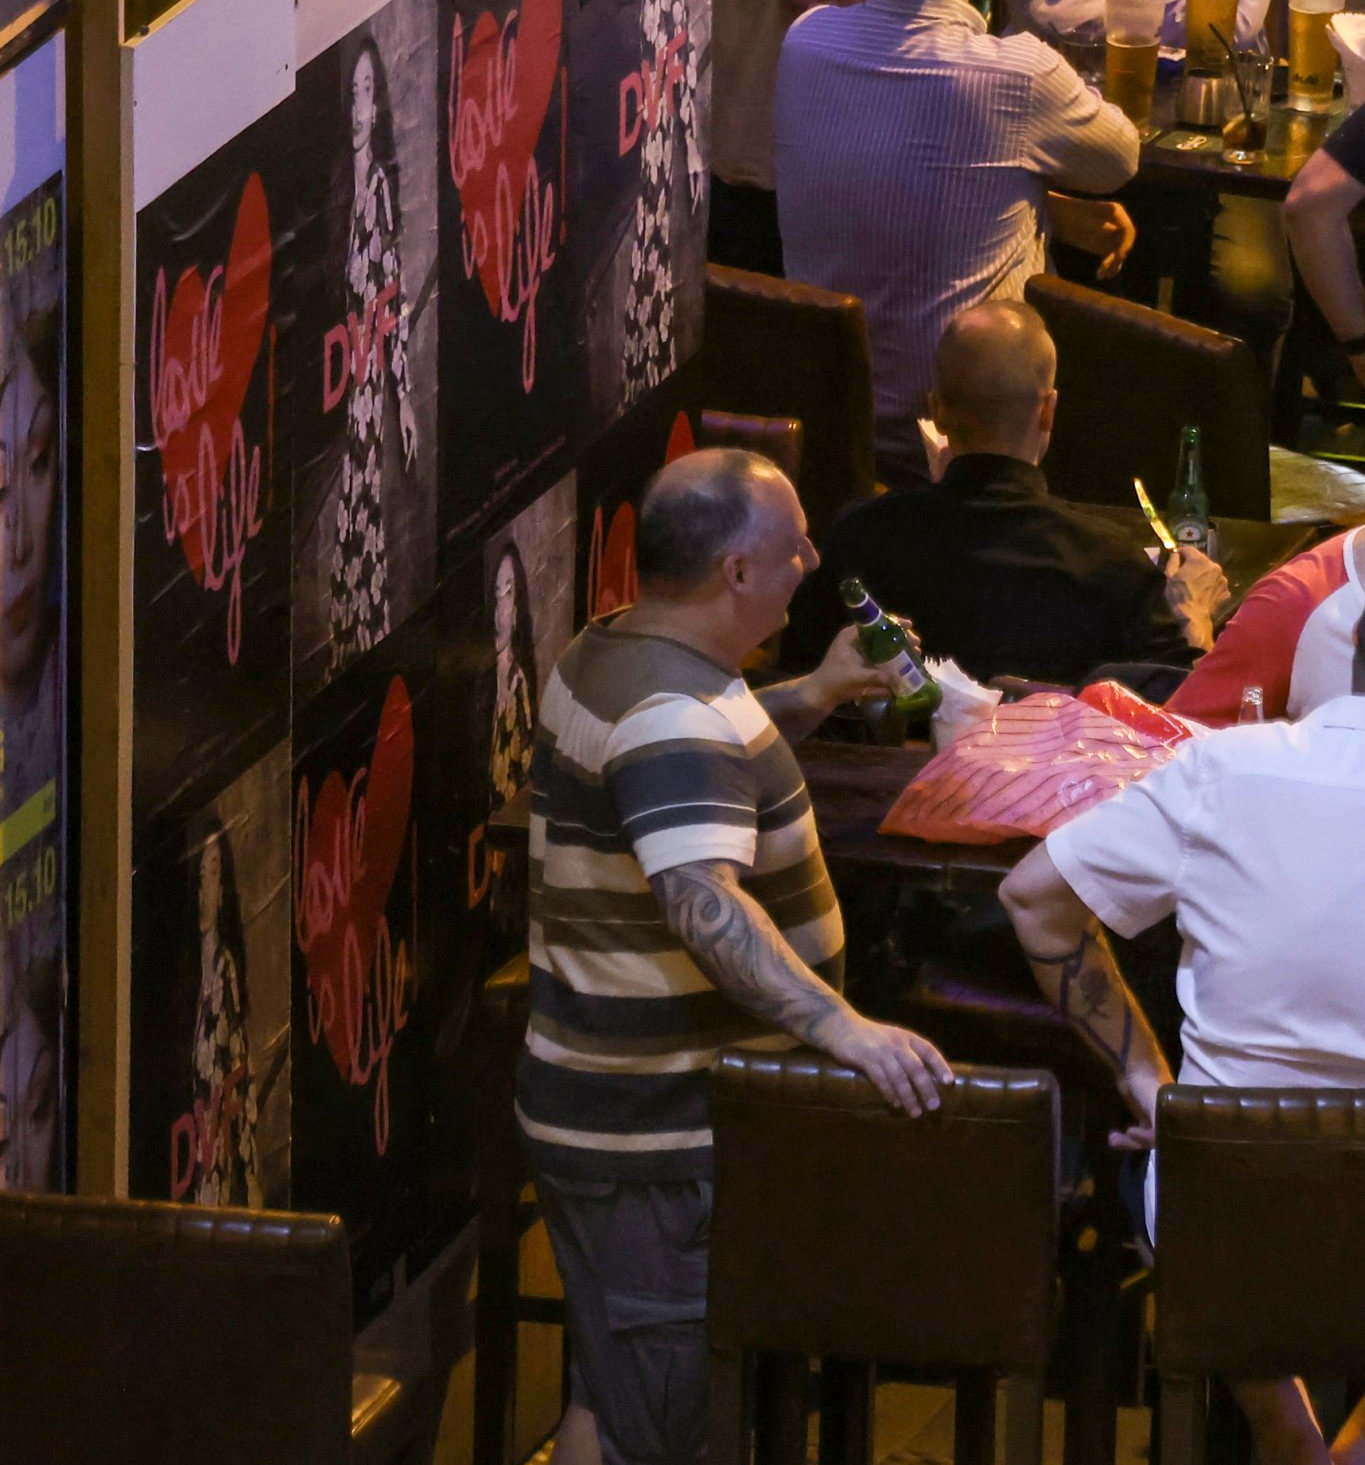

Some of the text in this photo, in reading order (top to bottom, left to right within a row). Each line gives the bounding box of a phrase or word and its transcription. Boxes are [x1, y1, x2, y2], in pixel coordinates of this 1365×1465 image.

[618, 29, 688, 159] DVF
[4, 197, 57, 277] 15.10
[322, 281, 400, 415] DVF
[3, 844, 57, 932] 15.10
[171, 1064, 248, 1202] DVF
